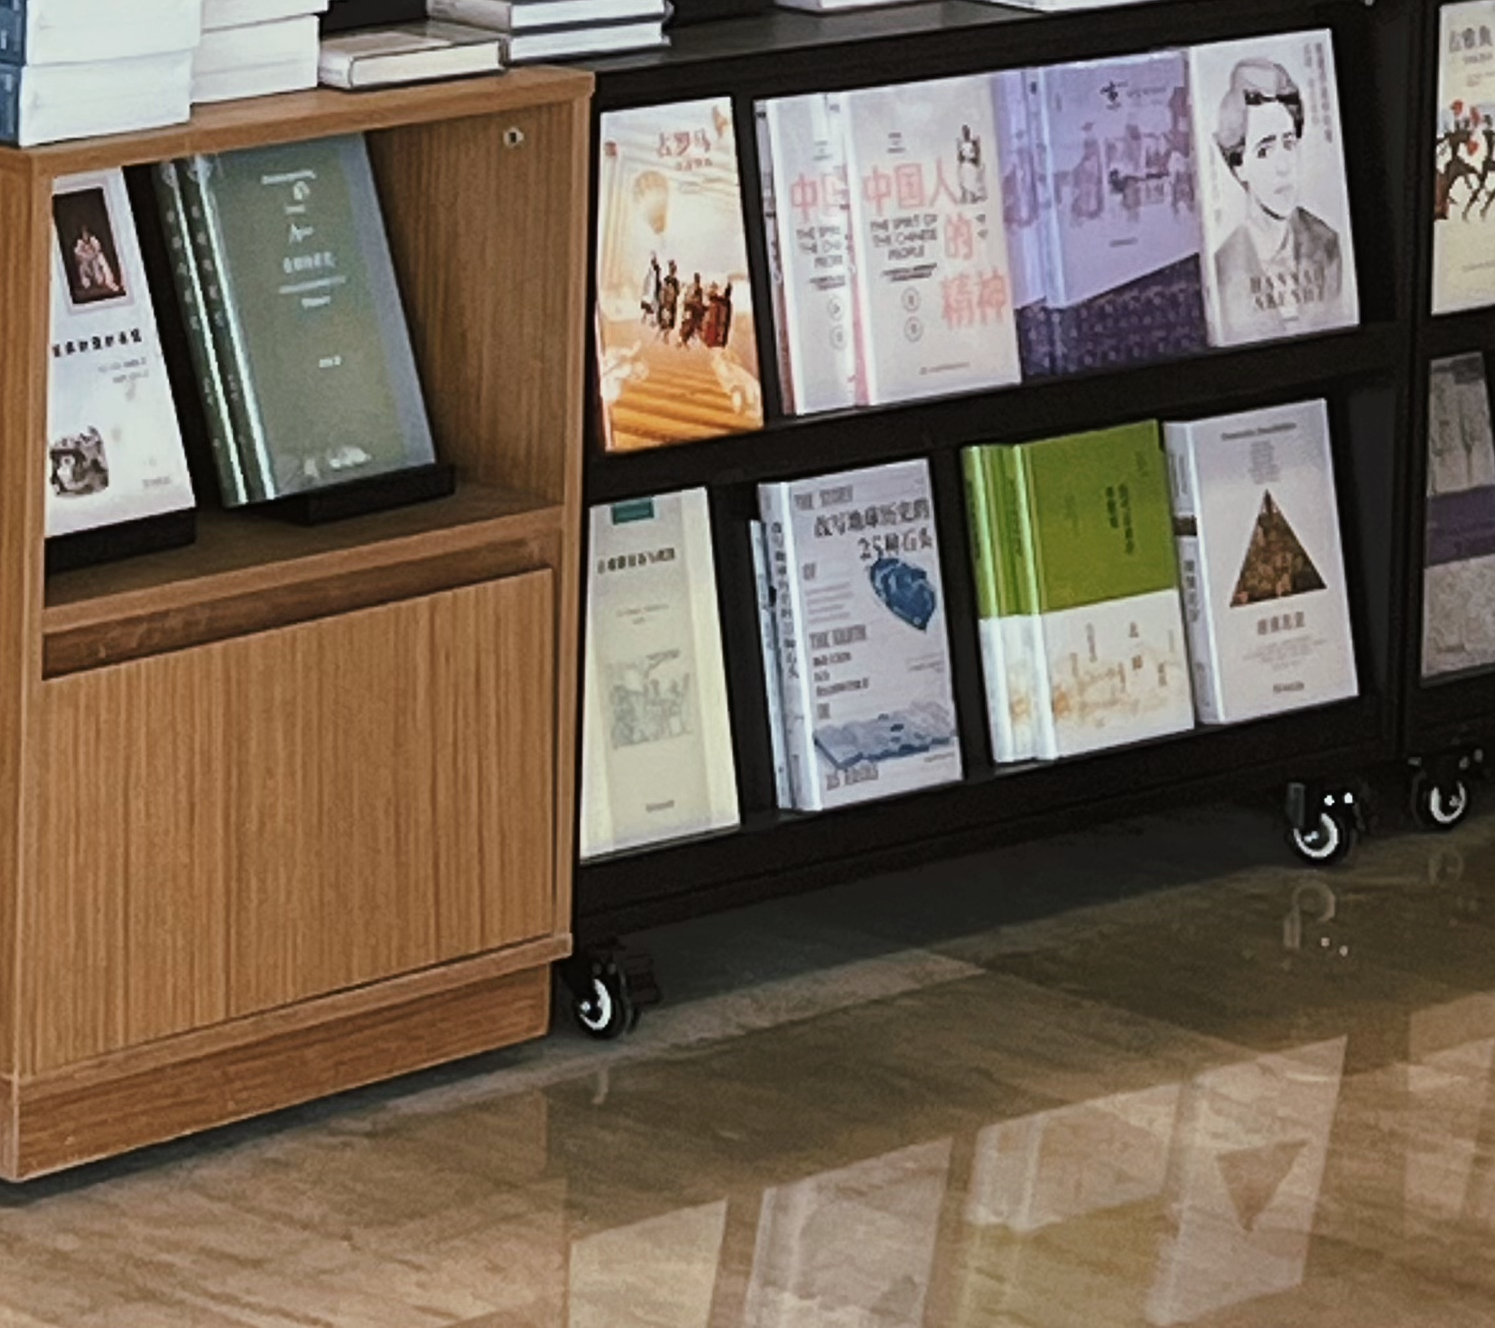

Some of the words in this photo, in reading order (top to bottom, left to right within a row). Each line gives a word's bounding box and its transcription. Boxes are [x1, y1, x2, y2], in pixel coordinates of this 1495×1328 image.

[863, 157, 971, 217] 中国人
[944, 211, 974, 261] 的
[941, 266, 1006, 330] 精神
